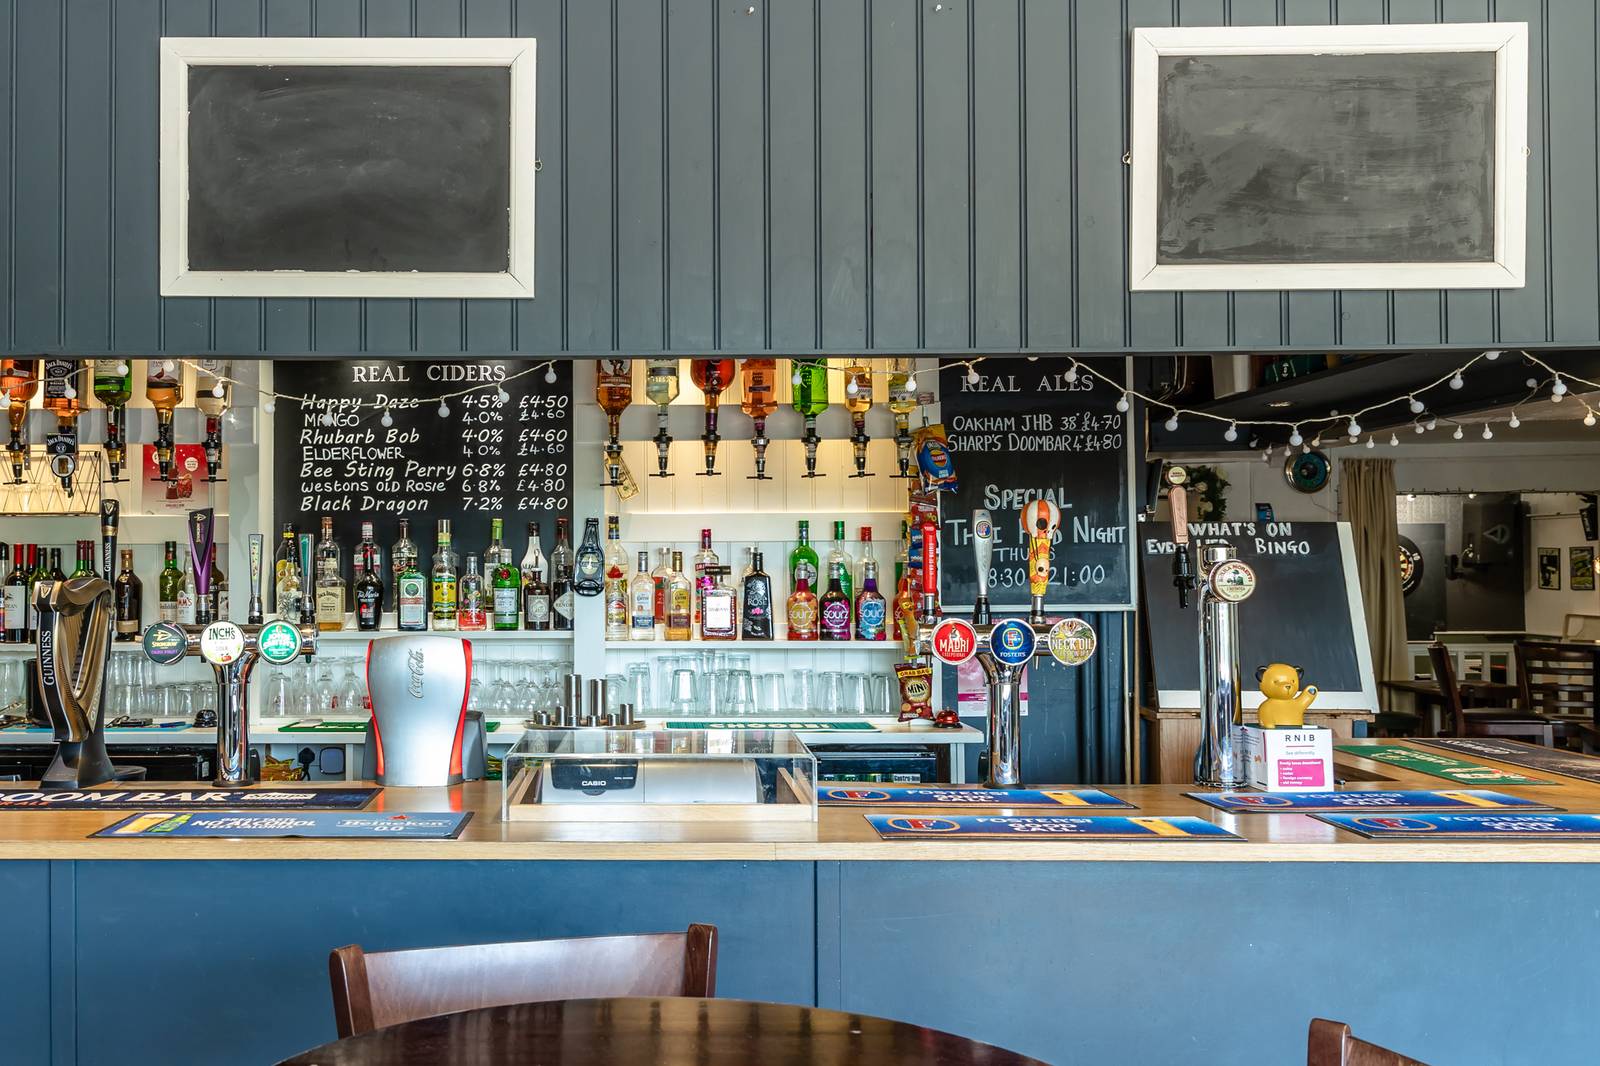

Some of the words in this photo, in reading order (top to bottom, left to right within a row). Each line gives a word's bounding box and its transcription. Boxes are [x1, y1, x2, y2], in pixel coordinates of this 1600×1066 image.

[353, 366, 410, 382] REAL
[427, 365, 506, 381] CIDERS
[960, 375, 1021, 392] REAL
[1036, 374, 1094, 392] ALES
[301, 394, 362, 412] Happy
[374, 394, 420, 409] Daze
[953, 415, 1016, 432] OAKHAM
[1021, 414, 1053, 431] JHB
[300, 429, 375, 445] Rhubarb
[386, 428, 420, 444] Bob
[948, 433, 1003, 452] SHARP'S
[1008, 433, 1071, 452] DOOMBAR
[303, 446, 405, 461] ELDERFLOWER
[300, 462, 333, 478] Bee
[344, 462, 394, 482] Sting
[405, 460, 457, 481] Perry
[300, 495, 351, 512] Black
[360, 496, 428, 515] Dragon
[1073, 516, 1126, 544] NIGHT
[1188, 522, 1256, 537] WHAT'S
[1266, 522, 1292, 537] ON
[1255, 538, 1310, 555] BINGO
[103, 542, 111, 572] GUINNESS
[208, 627, 236, 640] INCH'S
[1052, 638, 1076, 650] NECK
[1080, 638, 1092, 650] OIL
[42, 630, 54, 686] GUINNESS
[1285, 734, 1315, 742] RNIB
[0, 792, 129, 802] OOM
[125, 792, 232, 802] BAR
